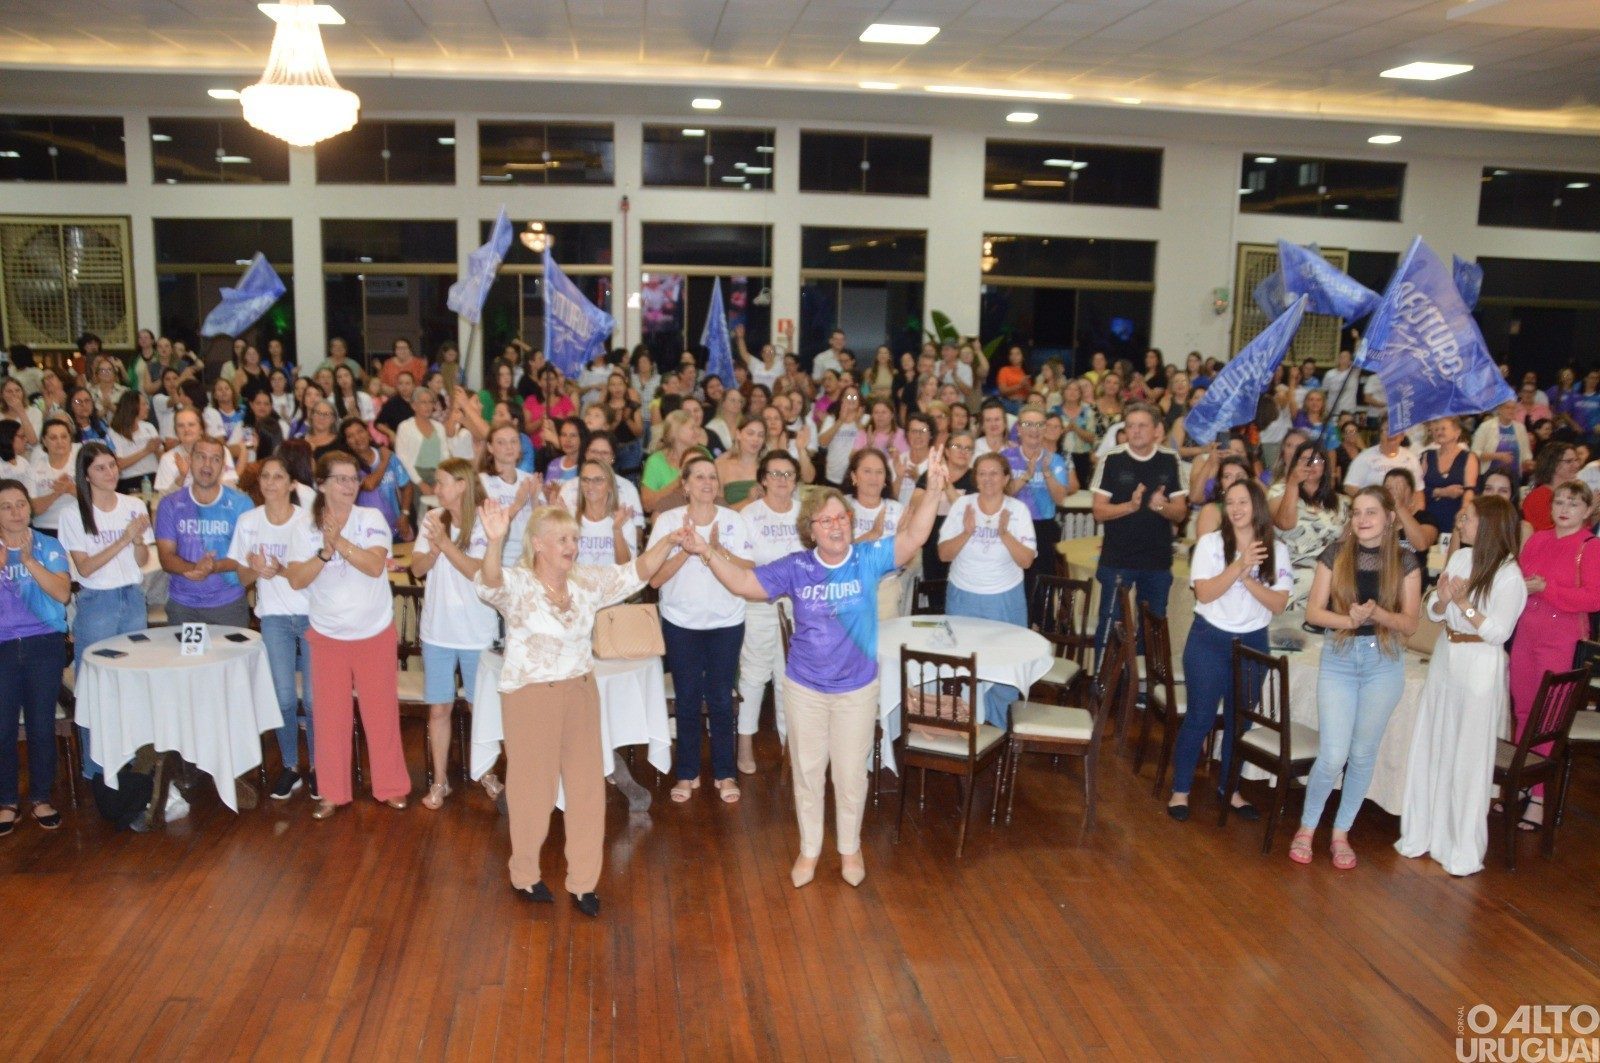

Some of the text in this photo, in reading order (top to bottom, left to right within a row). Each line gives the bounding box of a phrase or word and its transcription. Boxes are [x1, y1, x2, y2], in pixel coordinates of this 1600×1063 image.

[1402, 292, 1464, 377] FUTURO
[177, 519, 230, 536] O FUTURO
[801, 579, 862, 601] O FUTURO
[184, 625, 203, 643] 25
